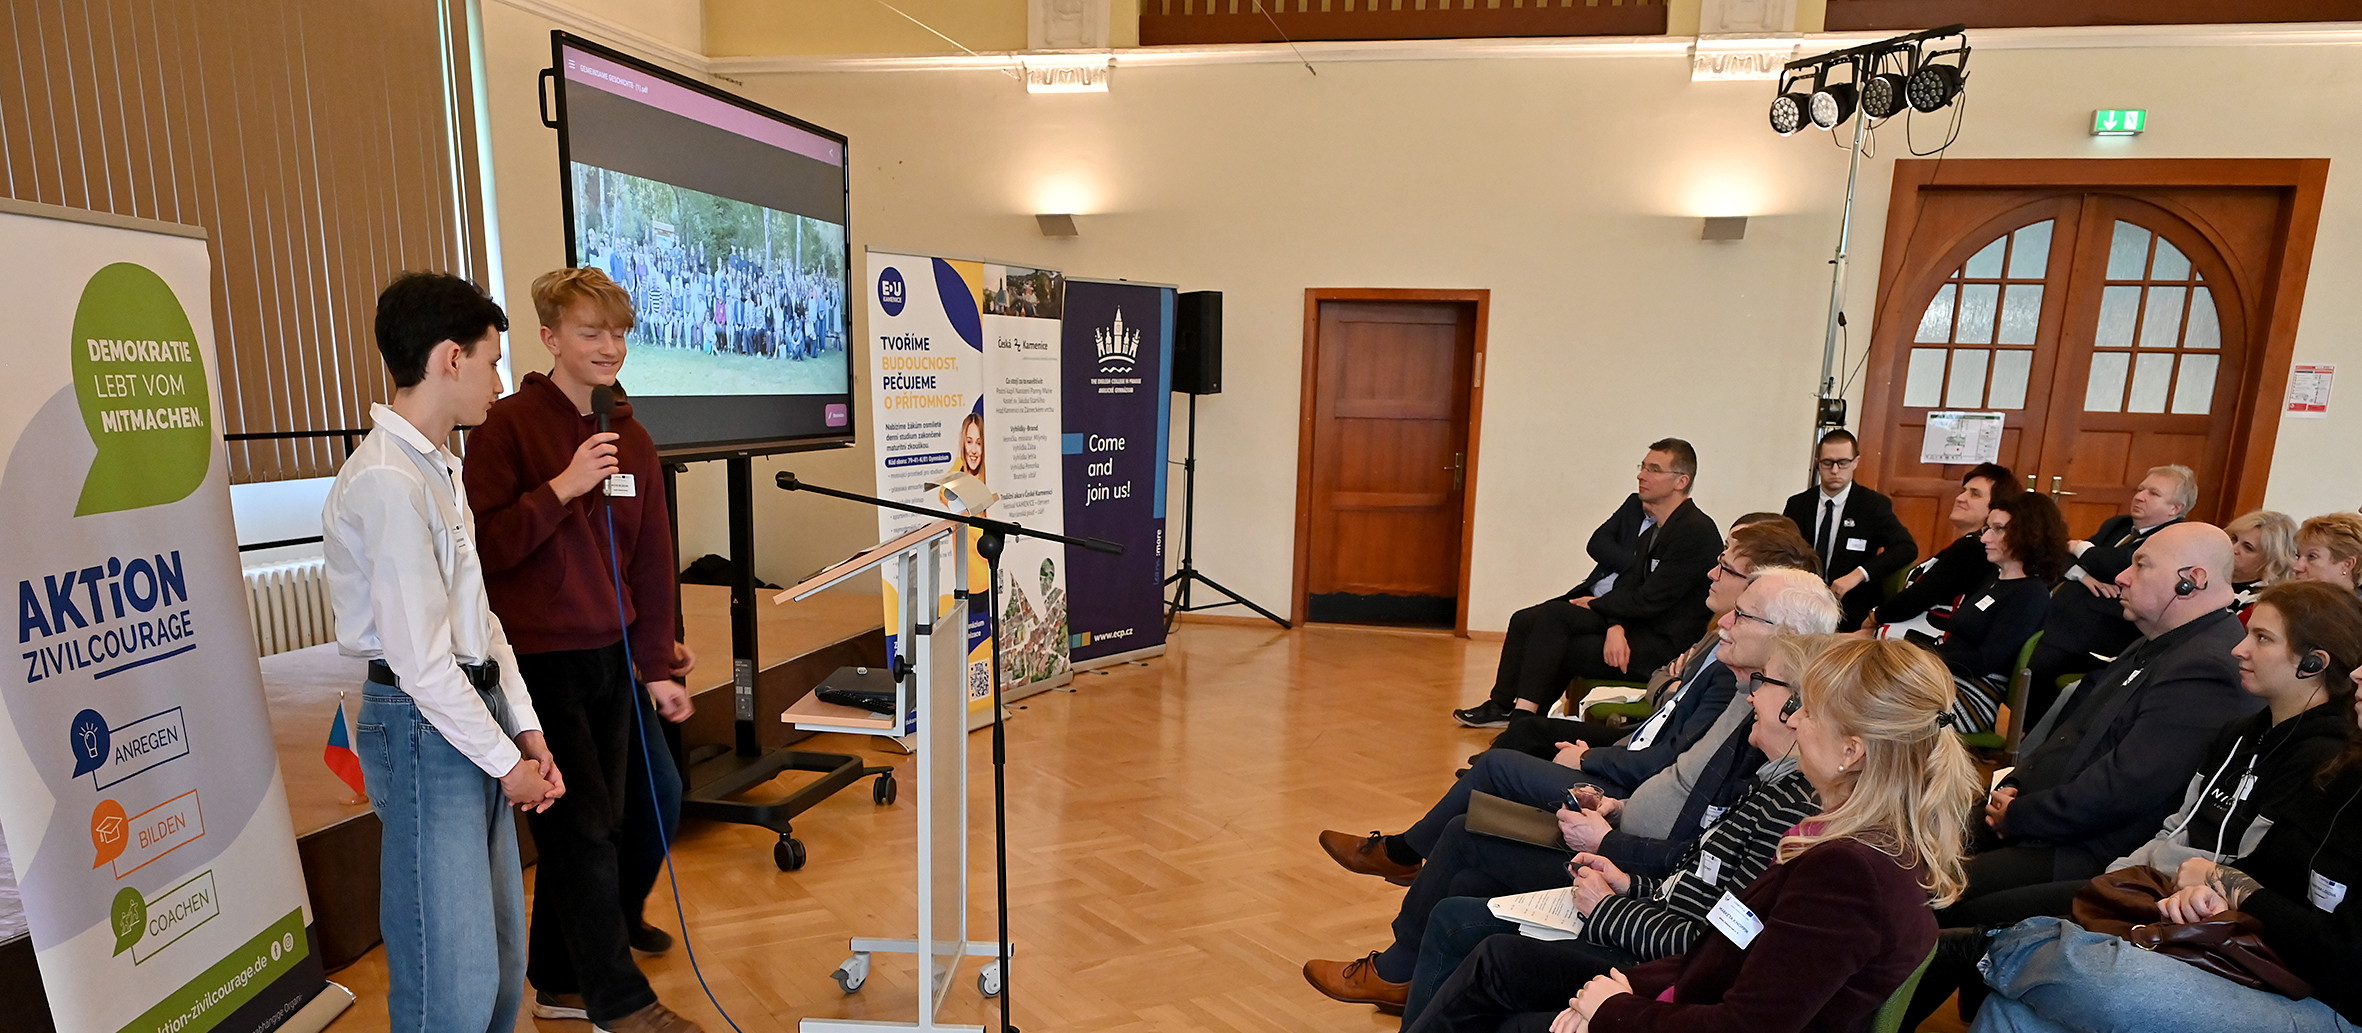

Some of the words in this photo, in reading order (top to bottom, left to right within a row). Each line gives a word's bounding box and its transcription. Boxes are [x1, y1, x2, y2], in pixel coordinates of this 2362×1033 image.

[87, 338, 192, 362] DEMOKRATIE
[880, 333, 930, 351] TVOŘÍME
[882, 356, 959, 372] BUDOUCNOST,
[94, 374, 137, 398] LEBT
[141, 374, 185, 396] VOM
[883, 371, 937, 390] PEČUJEME
[884, 396, 893, 410] O
[895, 391, 966, 410] PŘÍTOMNOST.
[101, 406, 204, 433] MITMACHEN.
[1088, 434, 1126, 452] Come
[1088, 457, 1113, 477] and
[1085, 482, 1110, 506] join
[1113, 480, 1131, 499] us!
[22, 609, 194, 684] ZIVILCOURAGE
[1093, 628, 1134, 642] www.ecp.cz
[115, 725, 179, 765] ANREGEN
[138, 812, 187, 849] BILDEN
[149, 889, 211, 937] COACHEN
